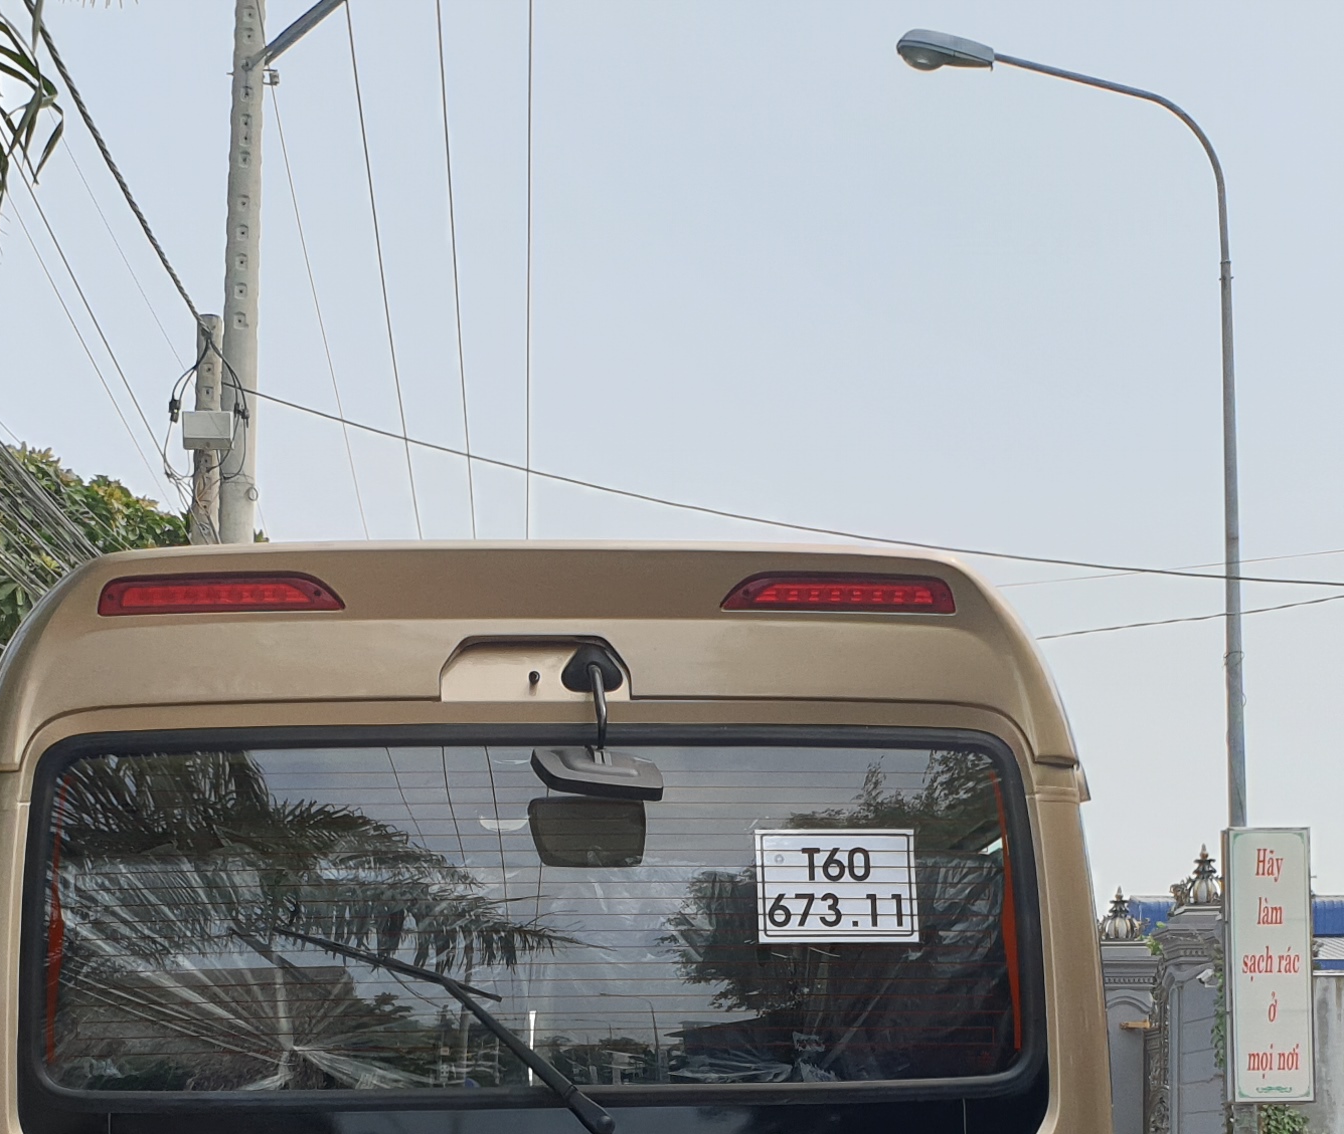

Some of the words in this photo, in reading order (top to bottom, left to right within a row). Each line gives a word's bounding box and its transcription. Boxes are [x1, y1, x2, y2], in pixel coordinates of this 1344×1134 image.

[801, 847, 871, 882] T60
[1255, 848, 1284, 883] Hãy
[768, 893, 903, 928] 673.11
[1256, 897, 1283, 926] làm
[1242, 946, 1273, 982] sạch
[1277, 947, 1300, 974] rác
[1268, 991, 1278, 1022] ở
[1247, 1043, 1273, 1080] mọi
